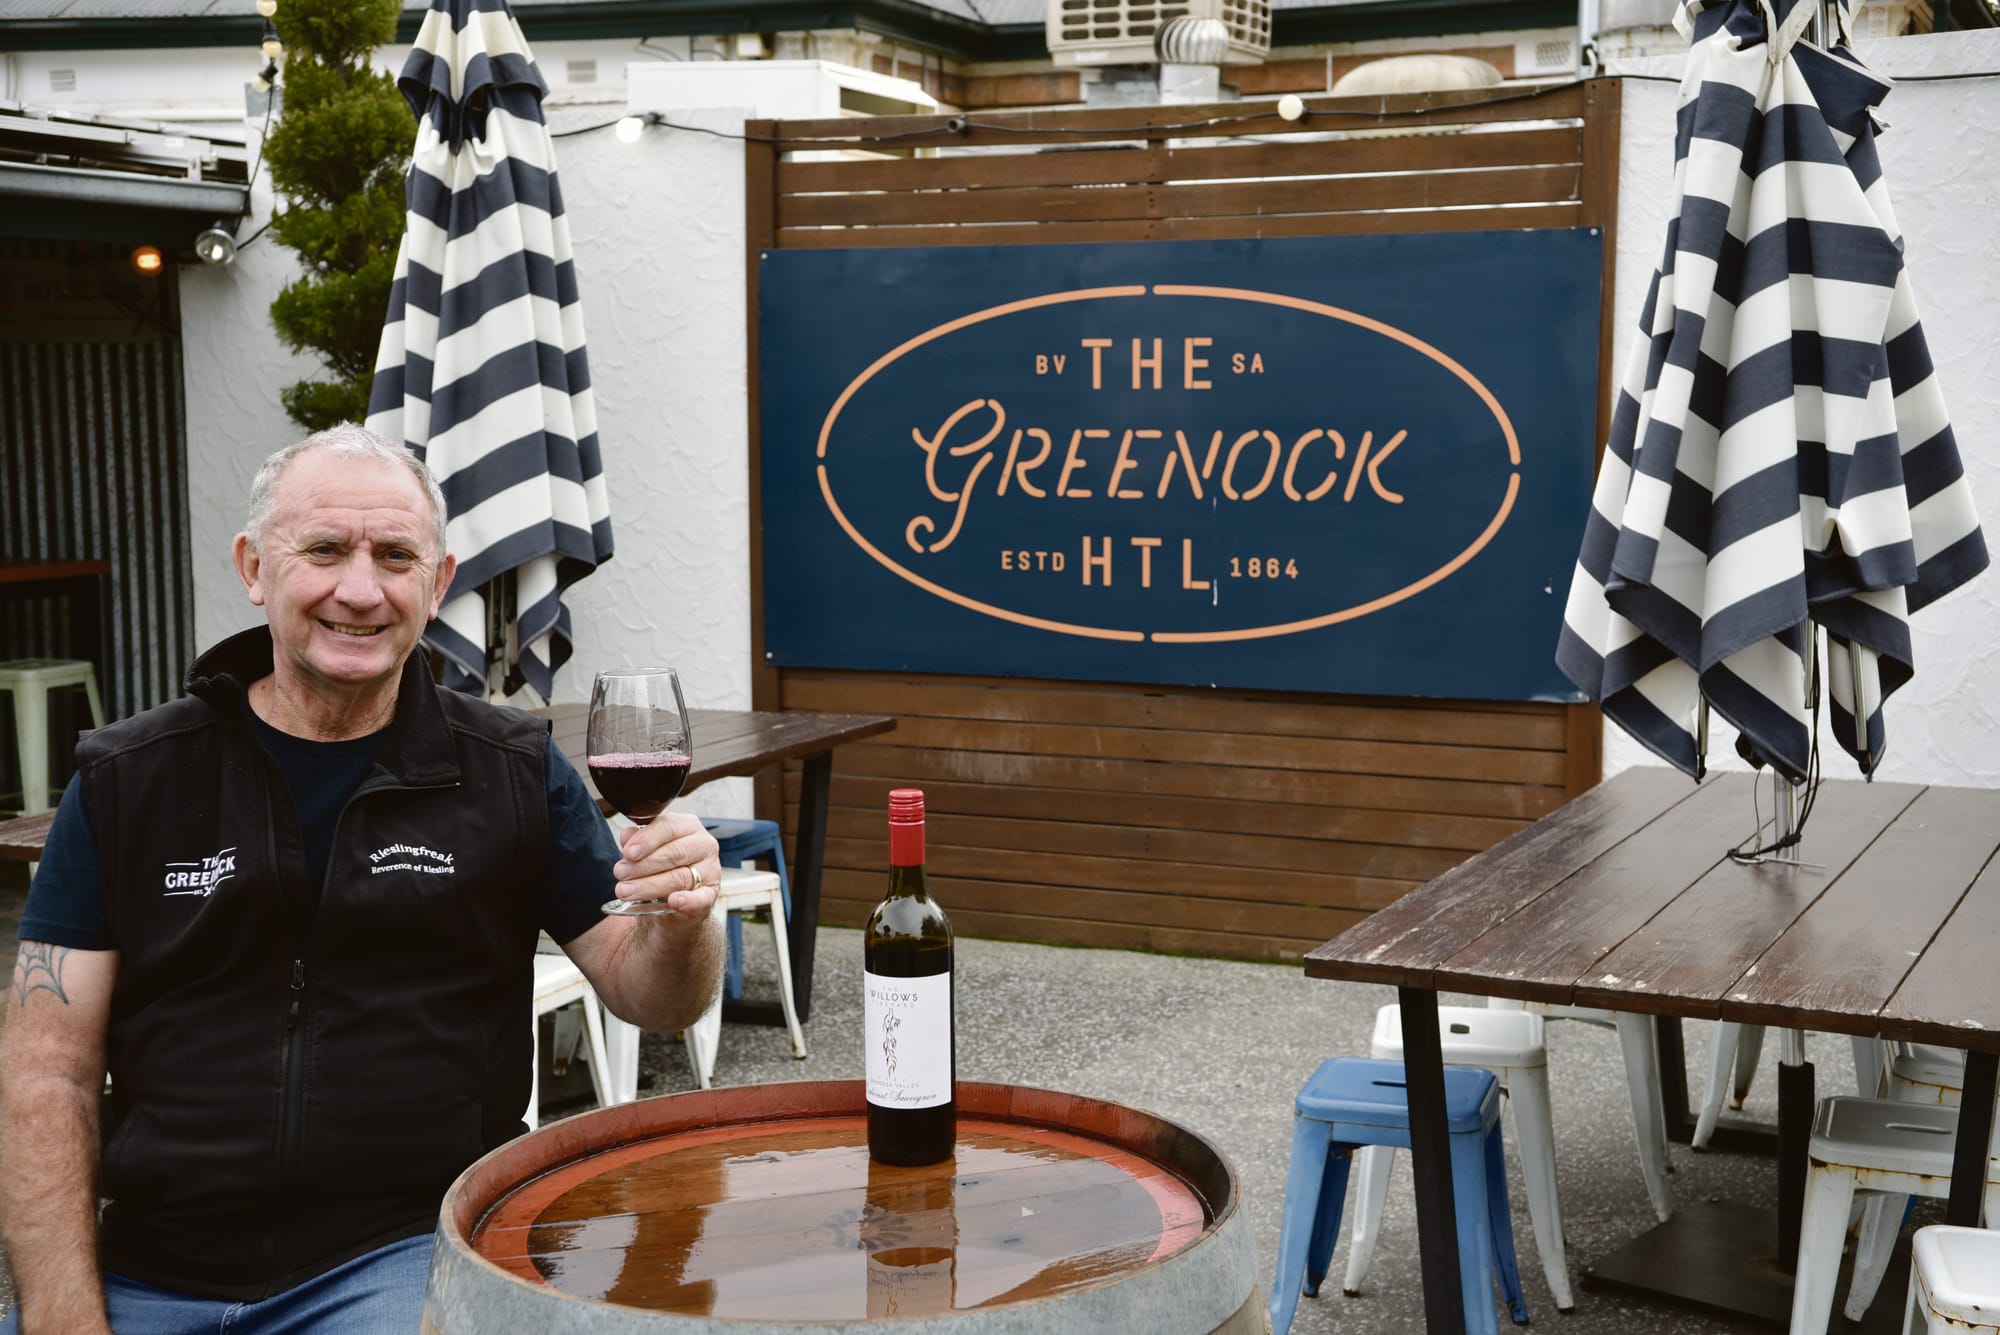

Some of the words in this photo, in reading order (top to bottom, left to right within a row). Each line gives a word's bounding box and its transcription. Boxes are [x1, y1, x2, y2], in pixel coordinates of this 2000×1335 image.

[1036, 355, 1066, 374] BV
[1081, 337, 1213, 390] THE
[1232, 353, 1265, 374] SA
[906, 399, 1408, 553] GREENOCK
[1001, 549, 1065, 572] ESTD
[1082, 535, 1210, 590] HTL
[1230, 557, 1299, 579] 1864
[369, 842, 454, 865] Rieslingfreak
[371, 862, 412, 875] Reverence
[413, 864, 422, 872] of
[423, 864, 455, 874] Riesling
[164, 855, 236, 889] GREENCK
[870, 990, 918, 1002] WILLOWS
